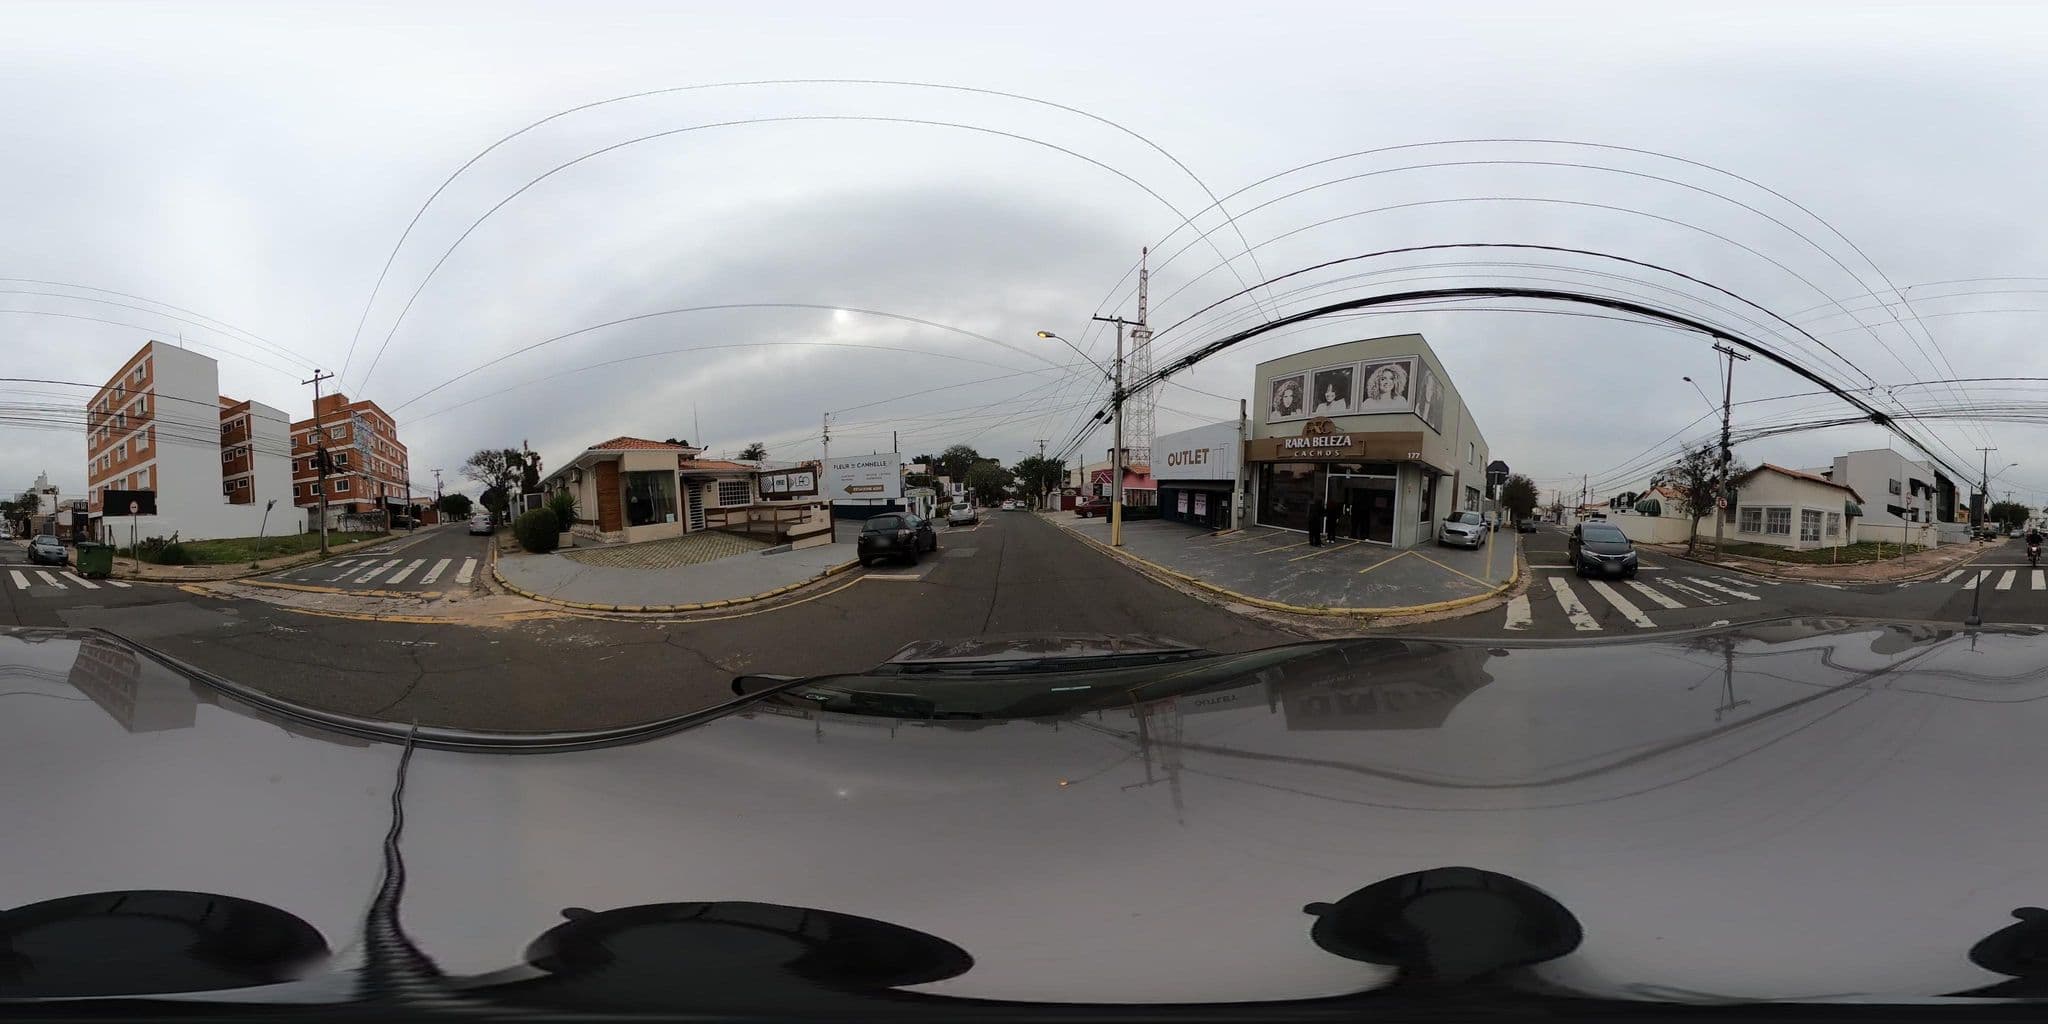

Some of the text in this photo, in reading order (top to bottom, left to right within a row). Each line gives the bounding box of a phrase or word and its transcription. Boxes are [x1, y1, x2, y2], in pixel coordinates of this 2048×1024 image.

[1285, 435, 1352, 448] RARA BELEZA
[1167, 448, 1209, 467] OUTLET
[856, 461, 886, 469] CANNELLE
